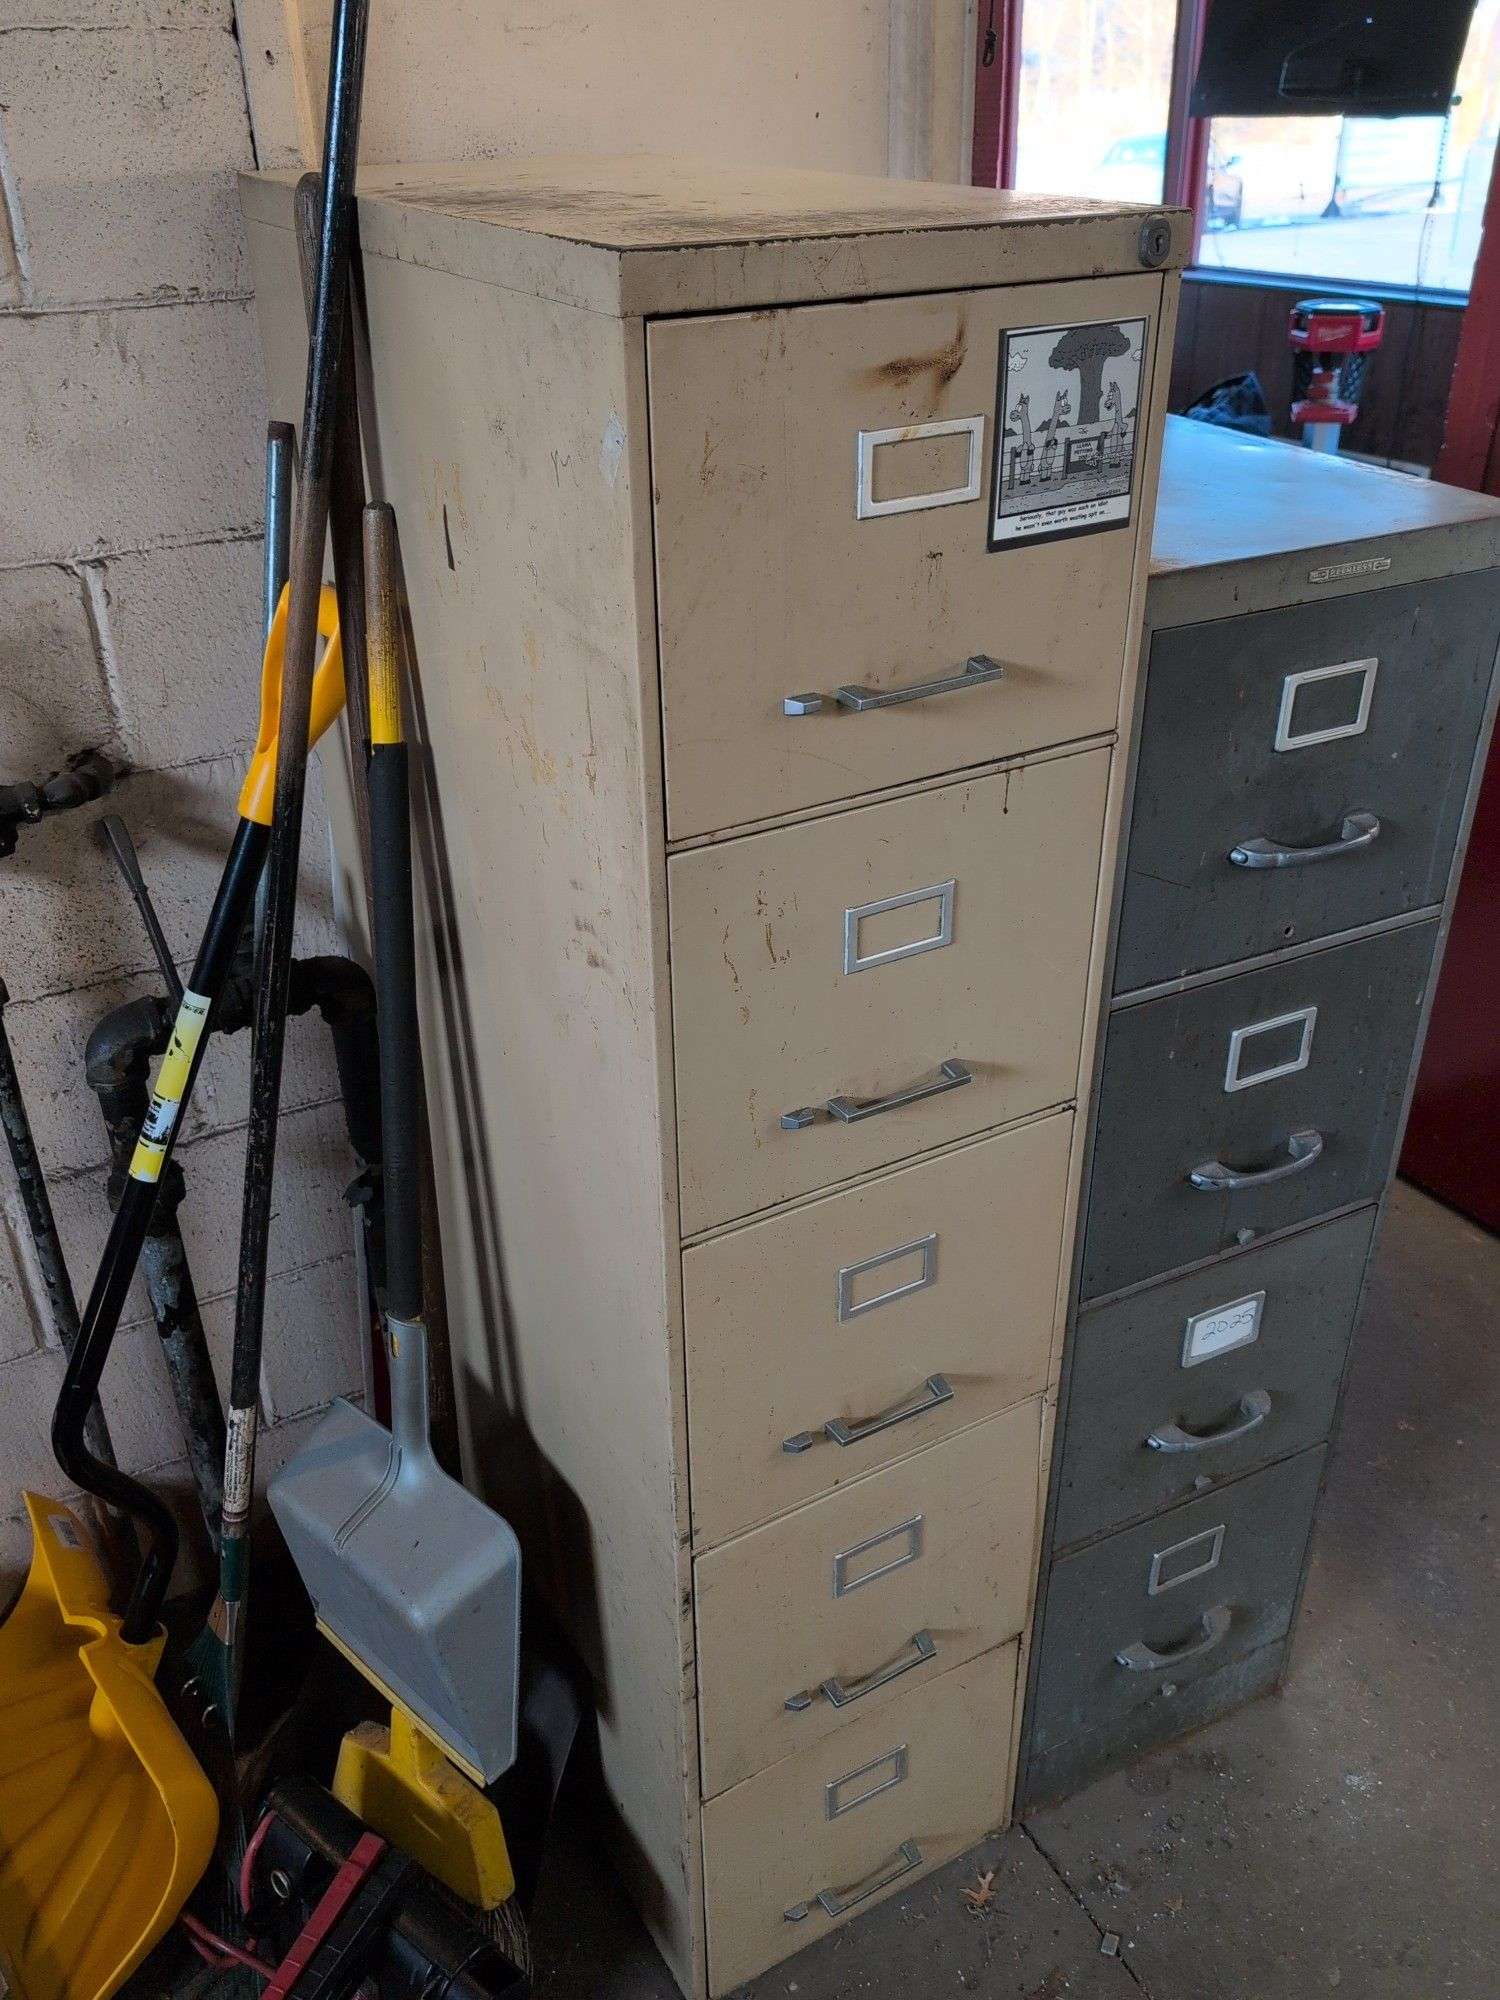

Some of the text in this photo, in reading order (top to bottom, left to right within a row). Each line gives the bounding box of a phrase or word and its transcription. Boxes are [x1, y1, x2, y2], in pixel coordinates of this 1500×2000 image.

[1023, 522, 1040, 530] wasn't
[1054, 516, 1068, 524] worth
[1069, 513, 1087, 522] wasting
[1088, 511, 1097, 519] spit
[1200, 1306, 1256, 1341] 2025
